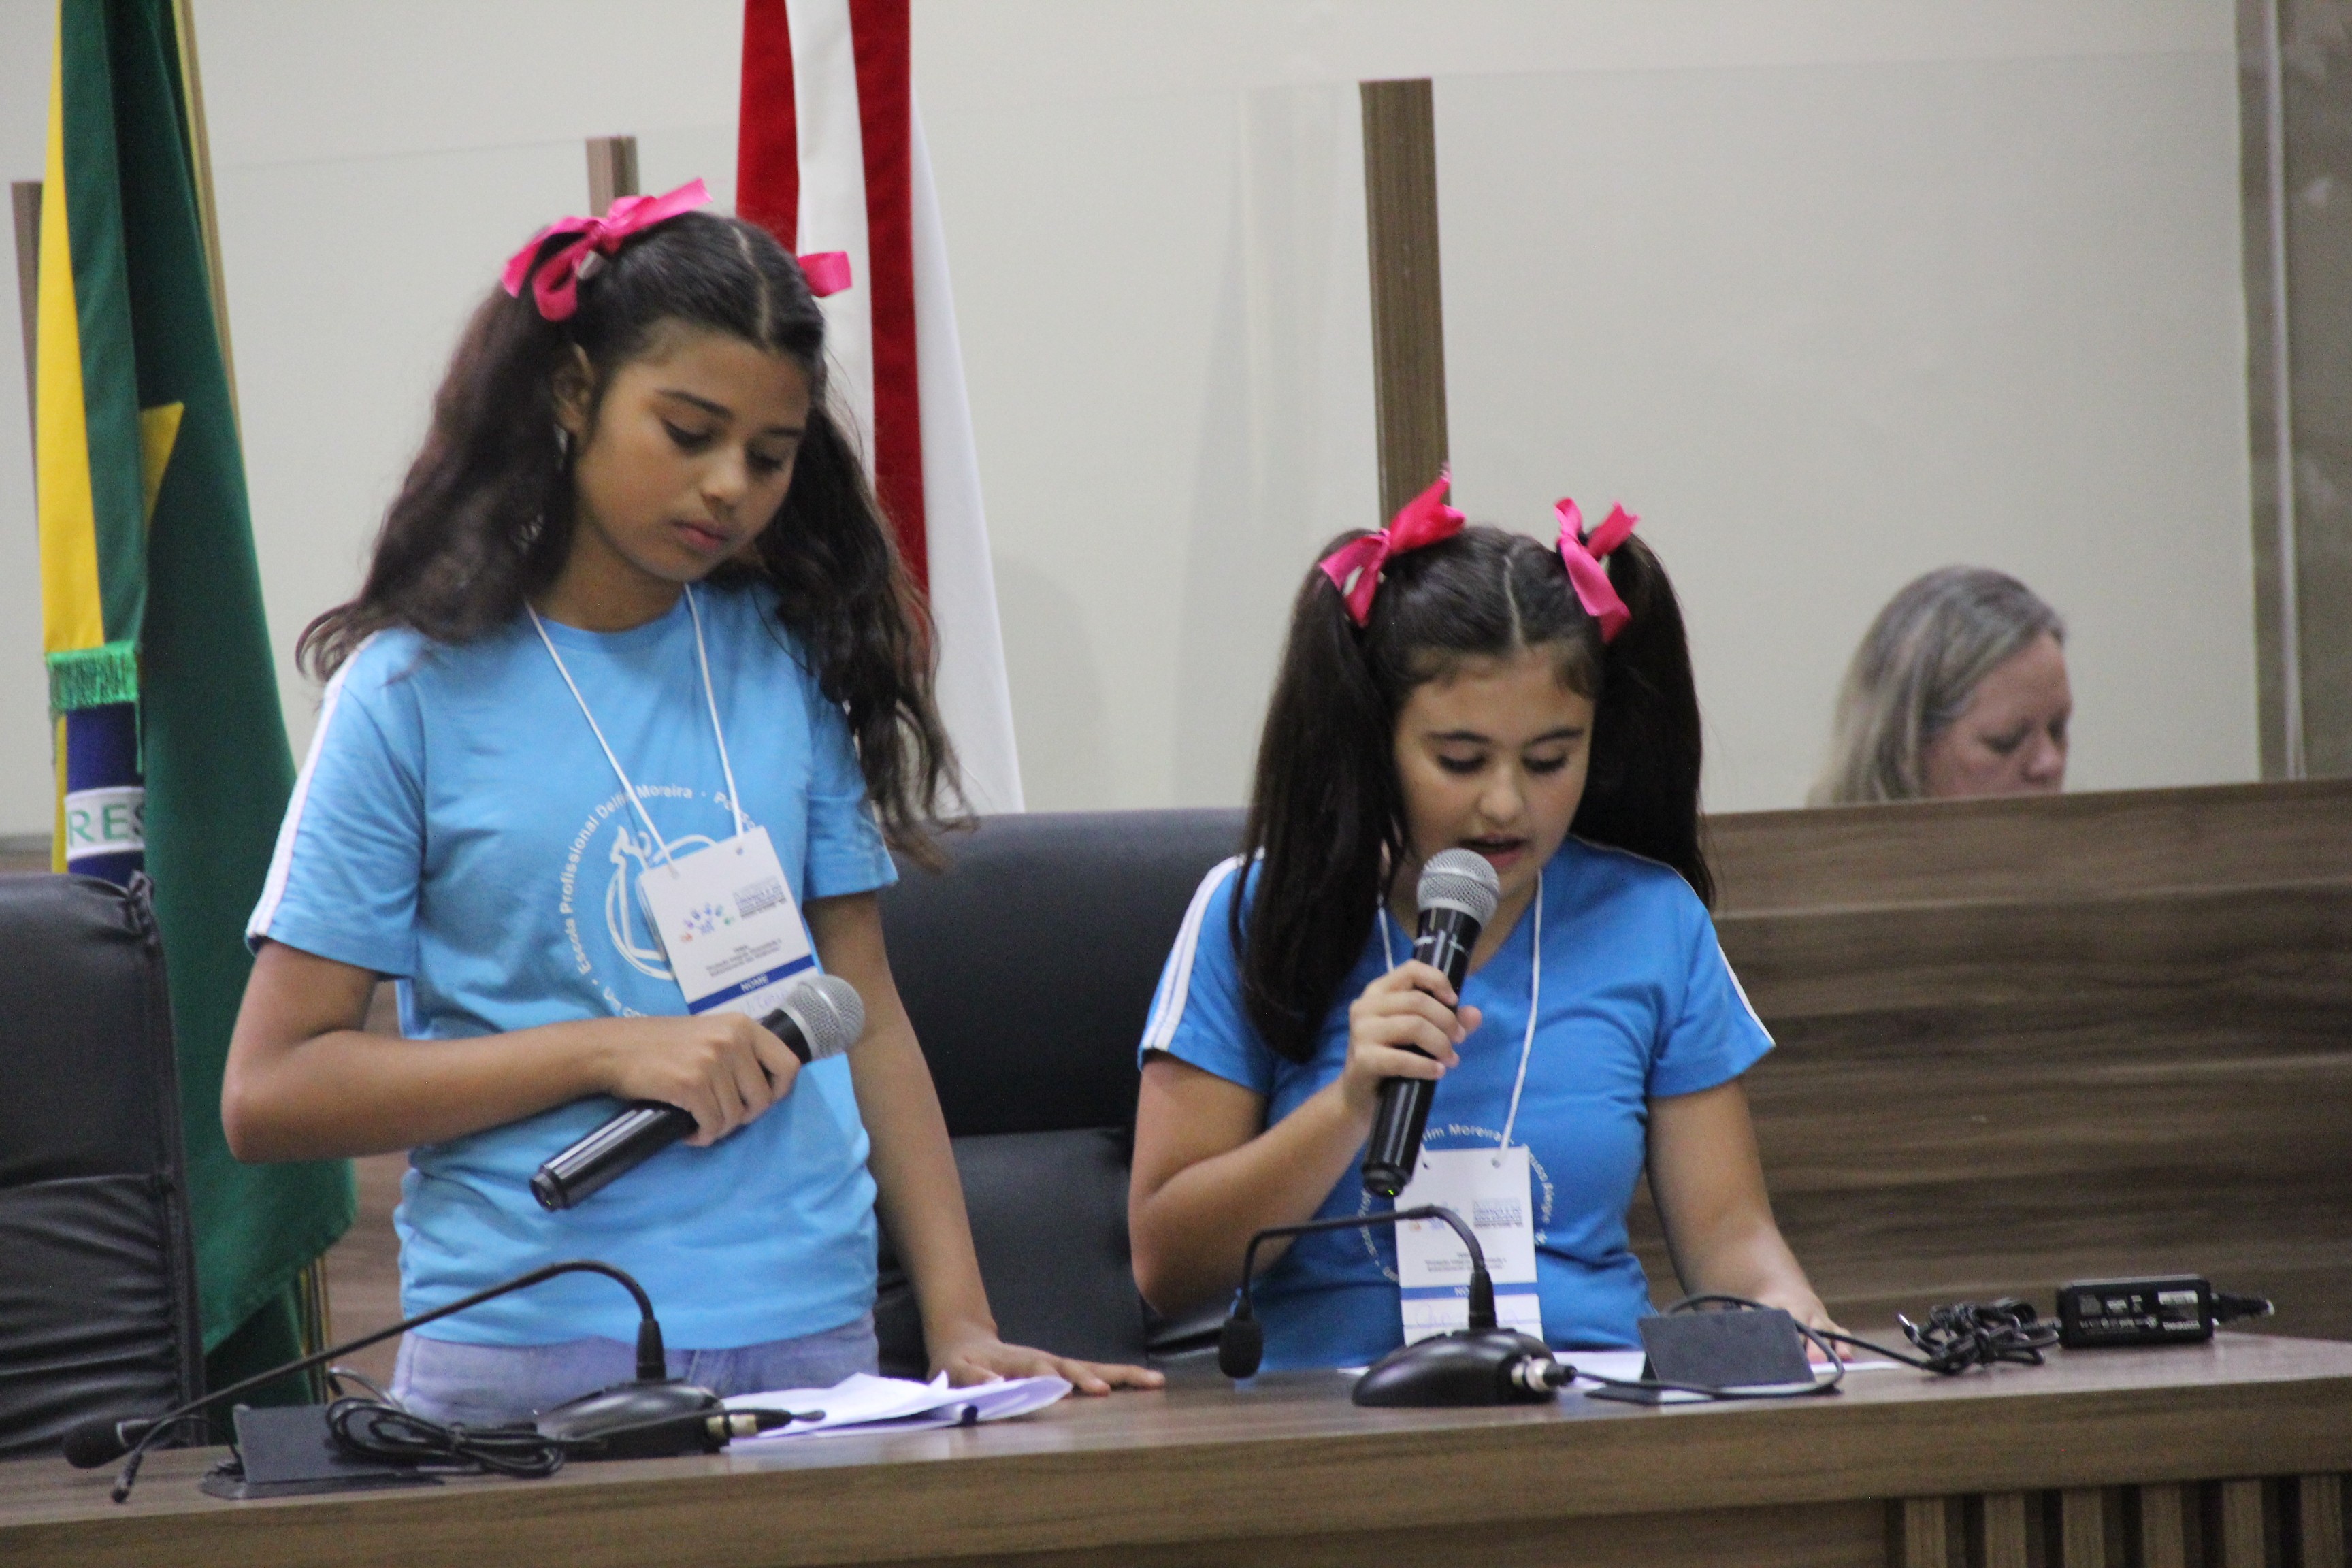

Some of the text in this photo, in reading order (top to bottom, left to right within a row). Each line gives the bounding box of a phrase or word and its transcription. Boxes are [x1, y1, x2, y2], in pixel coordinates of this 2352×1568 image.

[636, 784, 693, 799] Moreira
[559, 815, 600, 914] Profissional
[566, 918, 591, 975] Escola
[739, 974, 770, 993] NOME
[1448, 1123, 1501, 1142] Moreira
